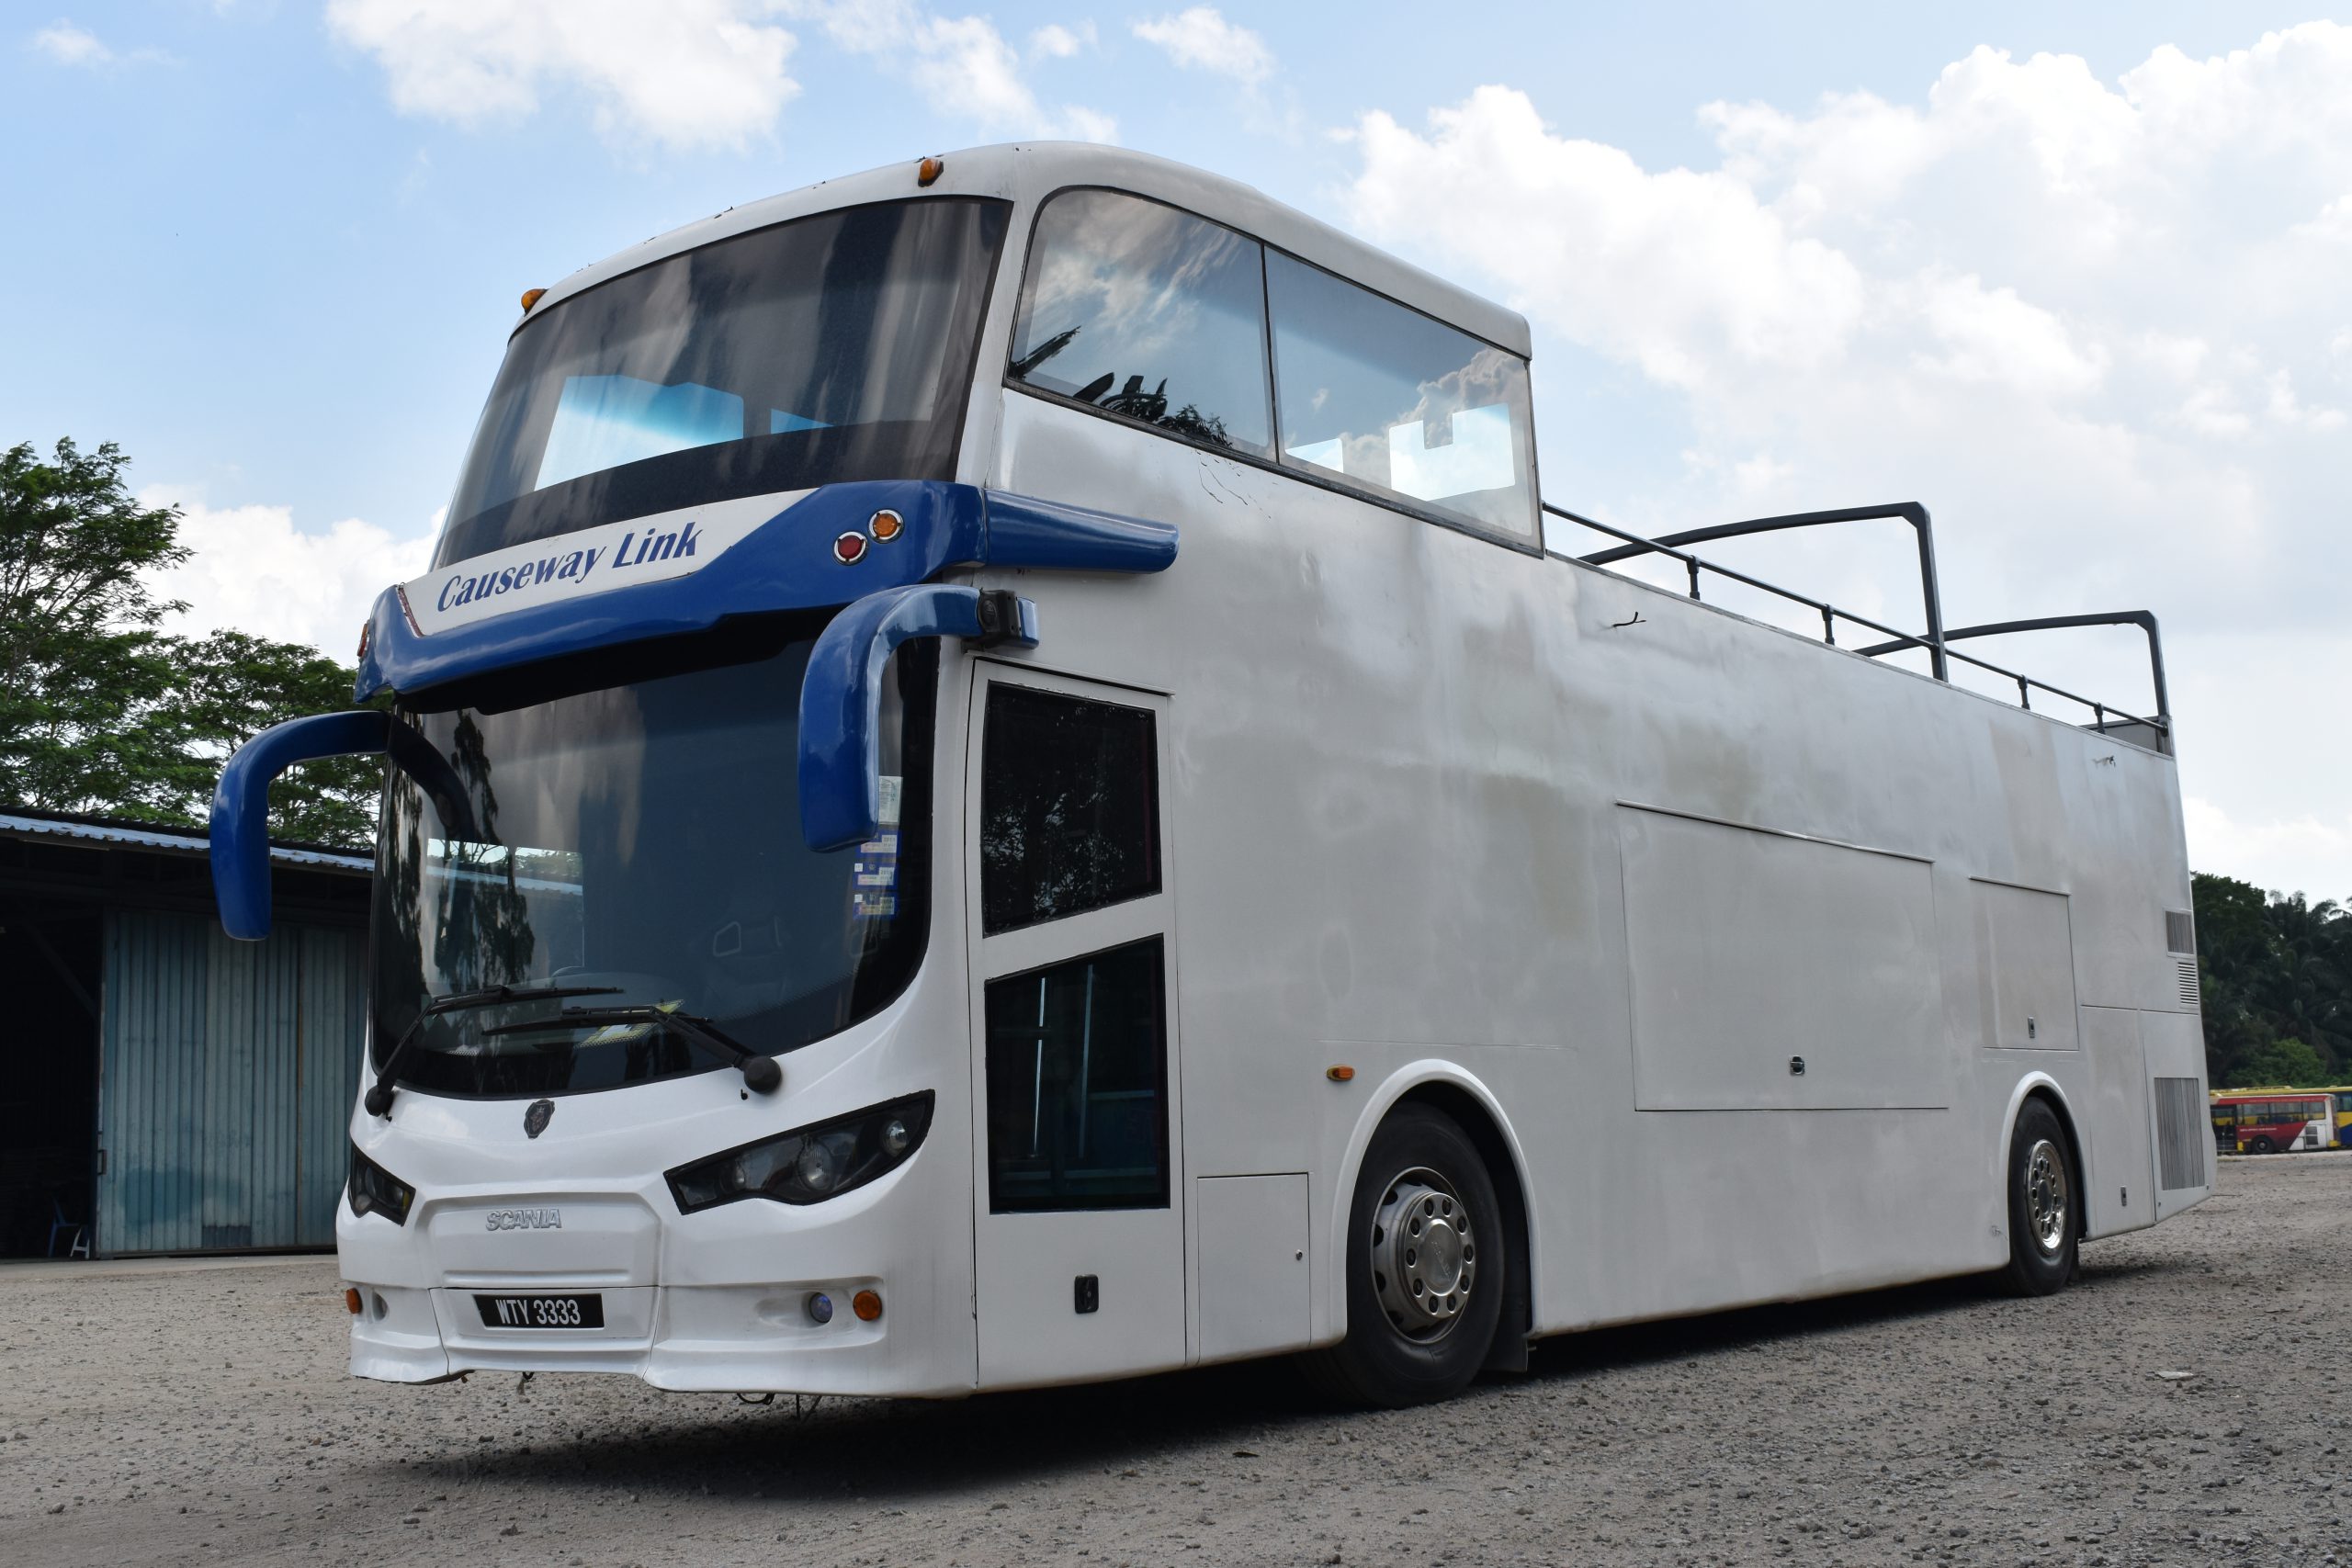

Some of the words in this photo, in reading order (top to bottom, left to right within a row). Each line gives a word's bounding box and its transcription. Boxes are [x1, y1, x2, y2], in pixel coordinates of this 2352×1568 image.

[437, 546, 607, 612] Causeway
[612, 522, 704, 569] Link
[485, 1209, 562, 1232] SCANIA
[495, 1299, 530, 1325] WTY
[533, 1299, 582, 1325] 3333
